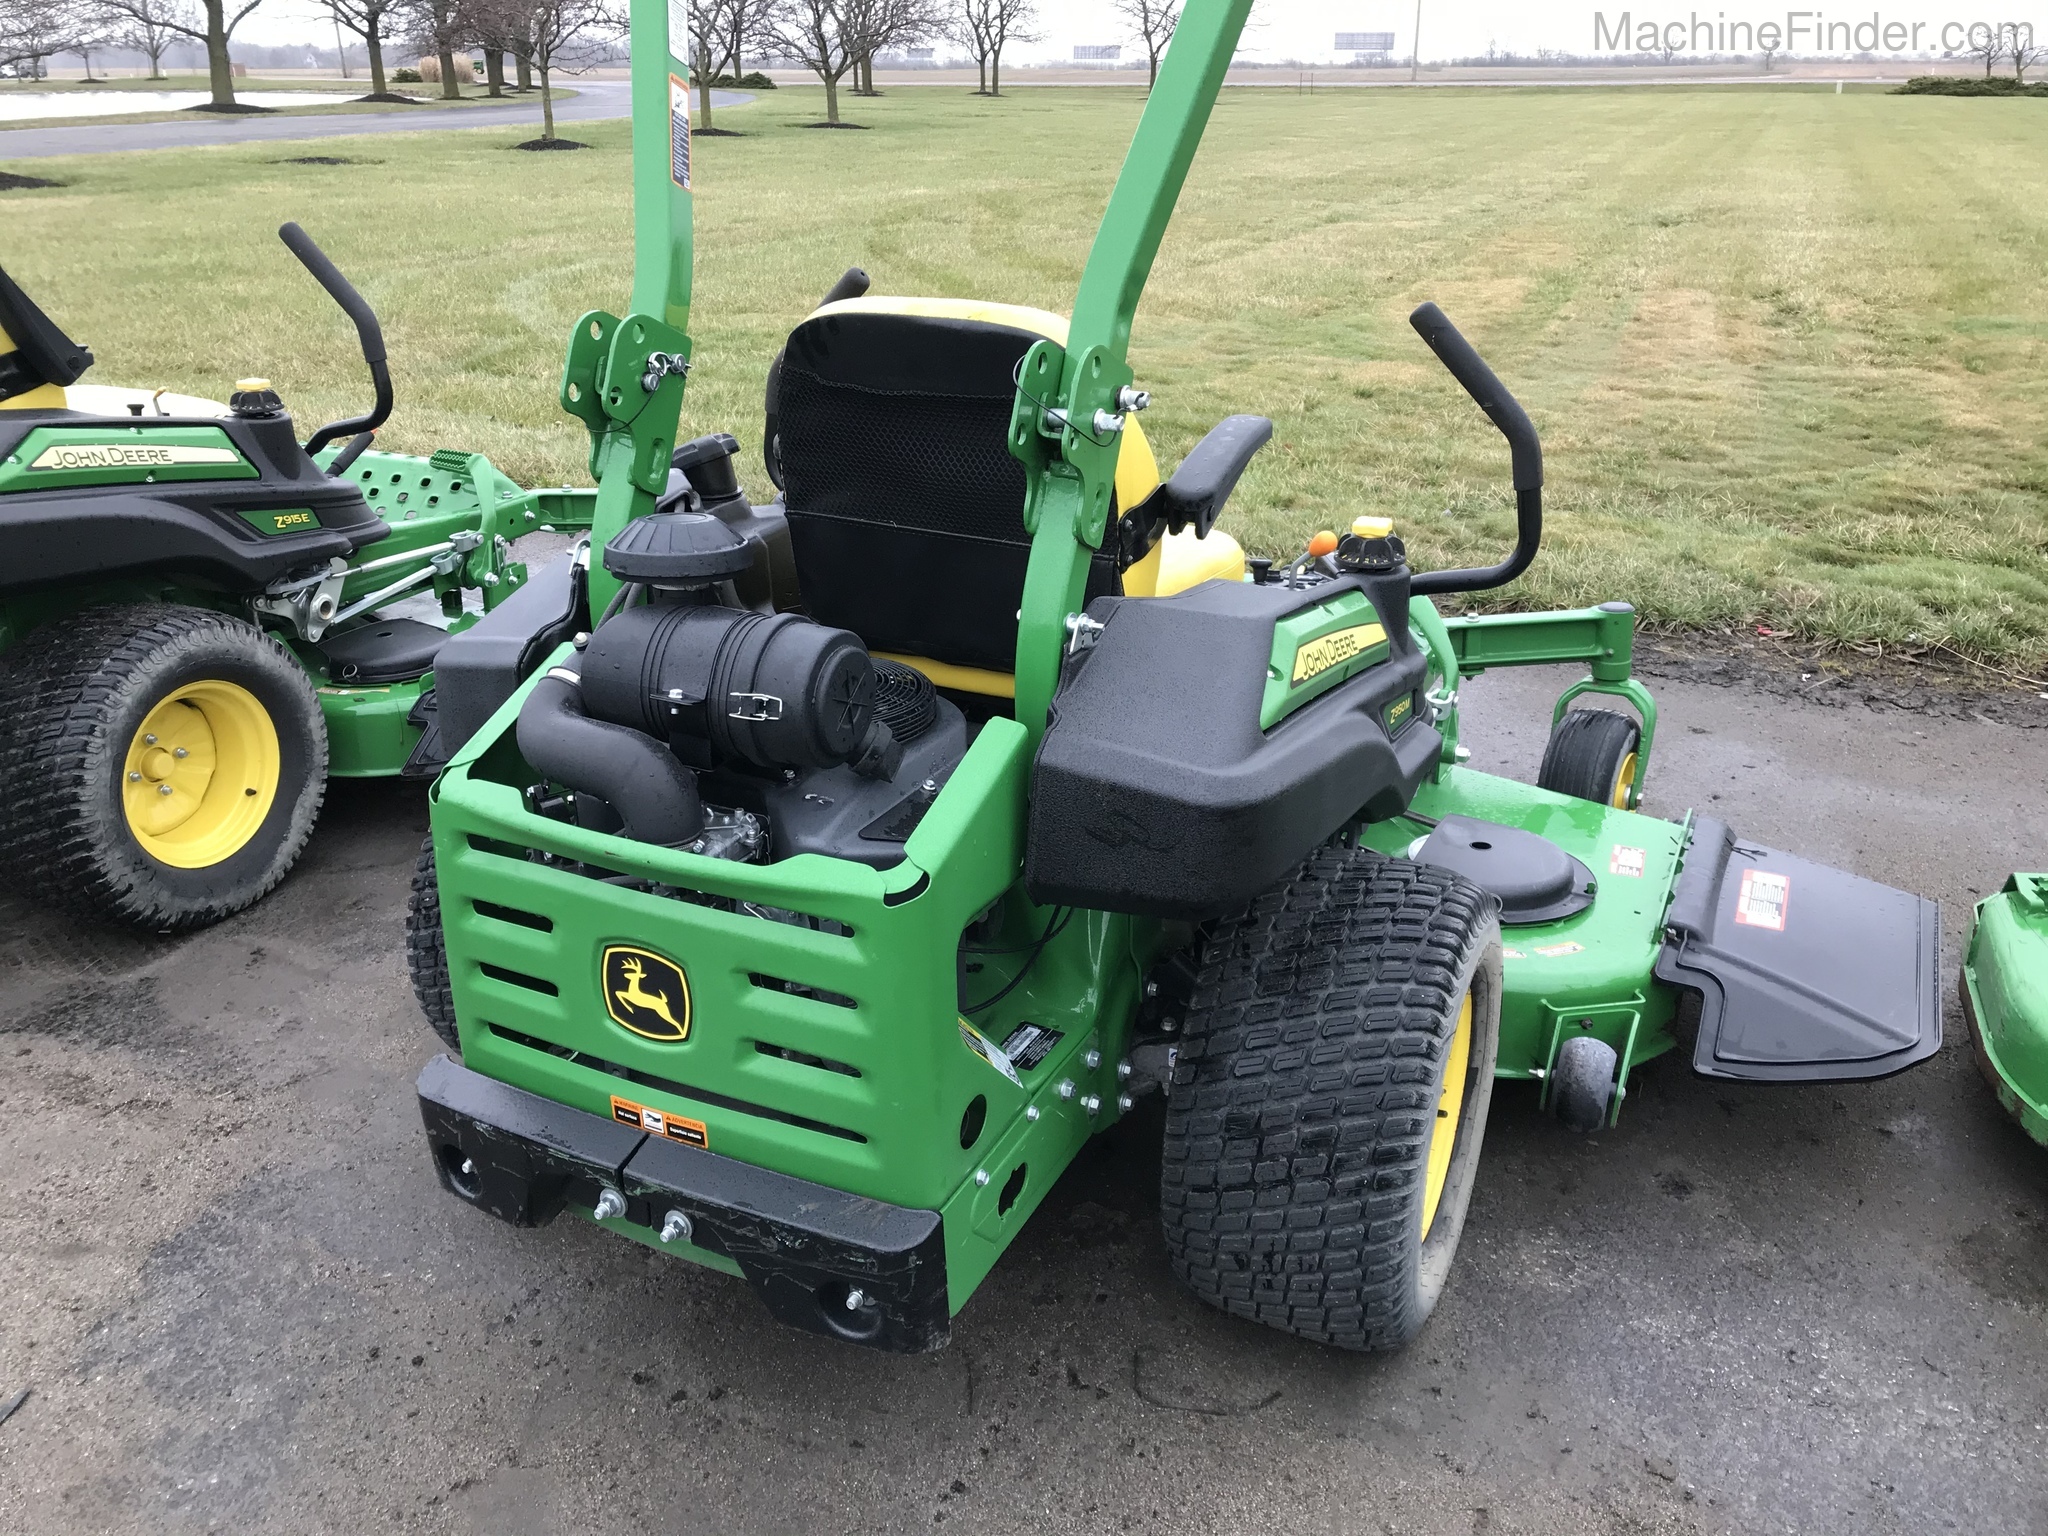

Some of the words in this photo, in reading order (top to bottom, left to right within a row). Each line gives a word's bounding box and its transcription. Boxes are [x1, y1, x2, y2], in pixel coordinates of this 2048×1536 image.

[53, 449, 107, 466] JOHN
[107, 447, 173, 463] DEERE
[273, 513, 311, 529] Z915E
[1301, 646, 1330, 676] JOHN
[1325, 633, 1359, 662] DEERE
